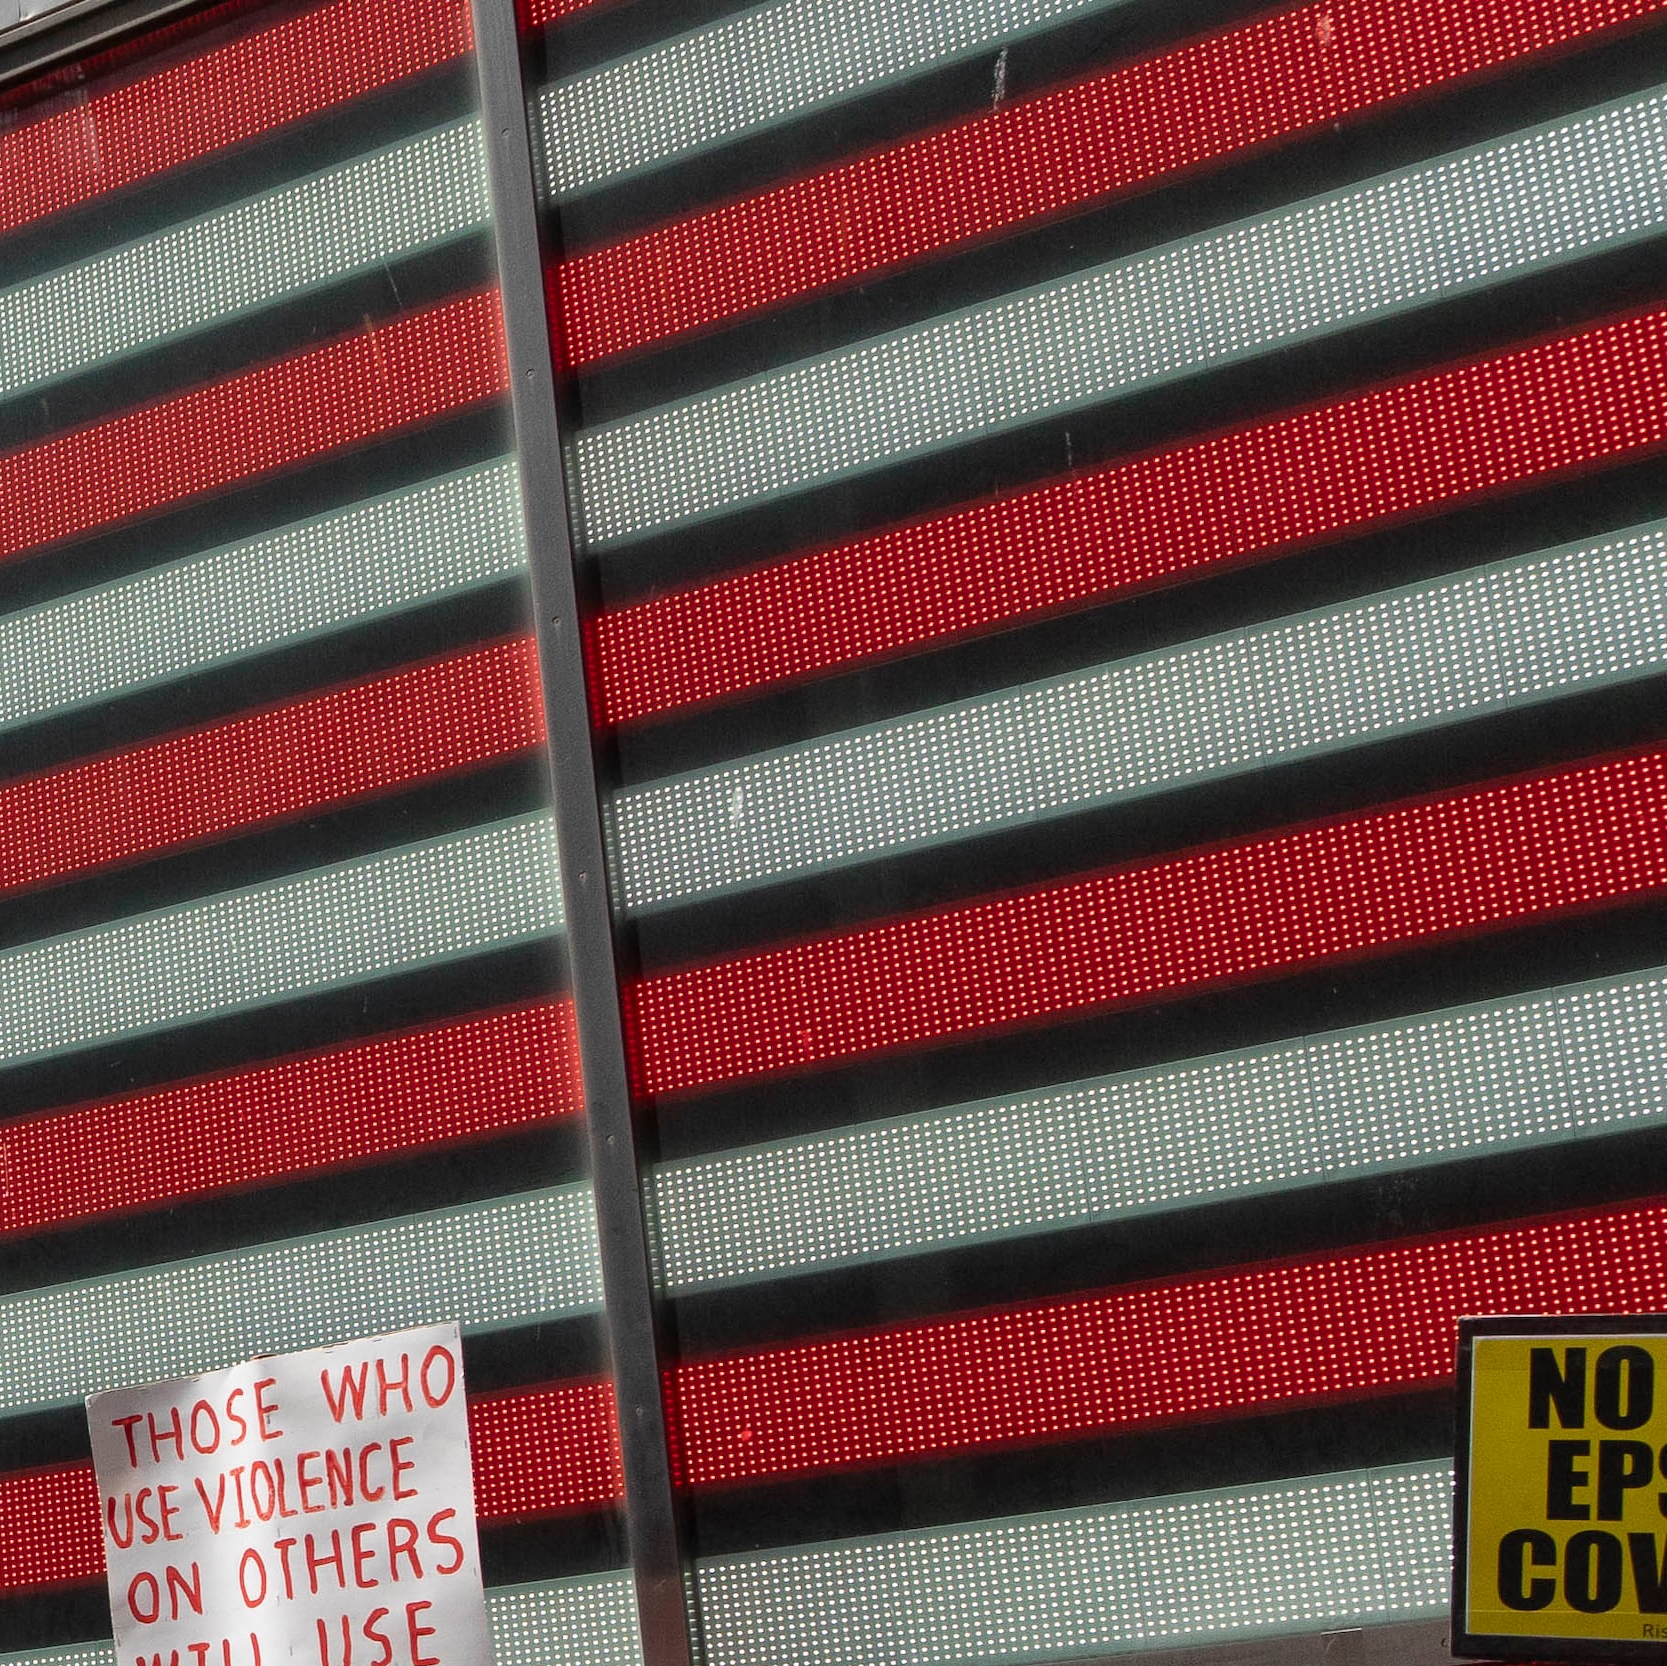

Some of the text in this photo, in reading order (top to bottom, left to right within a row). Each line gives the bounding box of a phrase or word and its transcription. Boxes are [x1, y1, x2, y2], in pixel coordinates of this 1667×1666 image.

[111, 1344, 456, 1468] THOSE WHO
[1527, 1344, 1655, 1431] NO
[107, 1436, 419, 1550] USE VIOLENCE
[1545, 1439, 1667, 1522] EP
[126, 1507, 466, 1625] ON OTHERS
